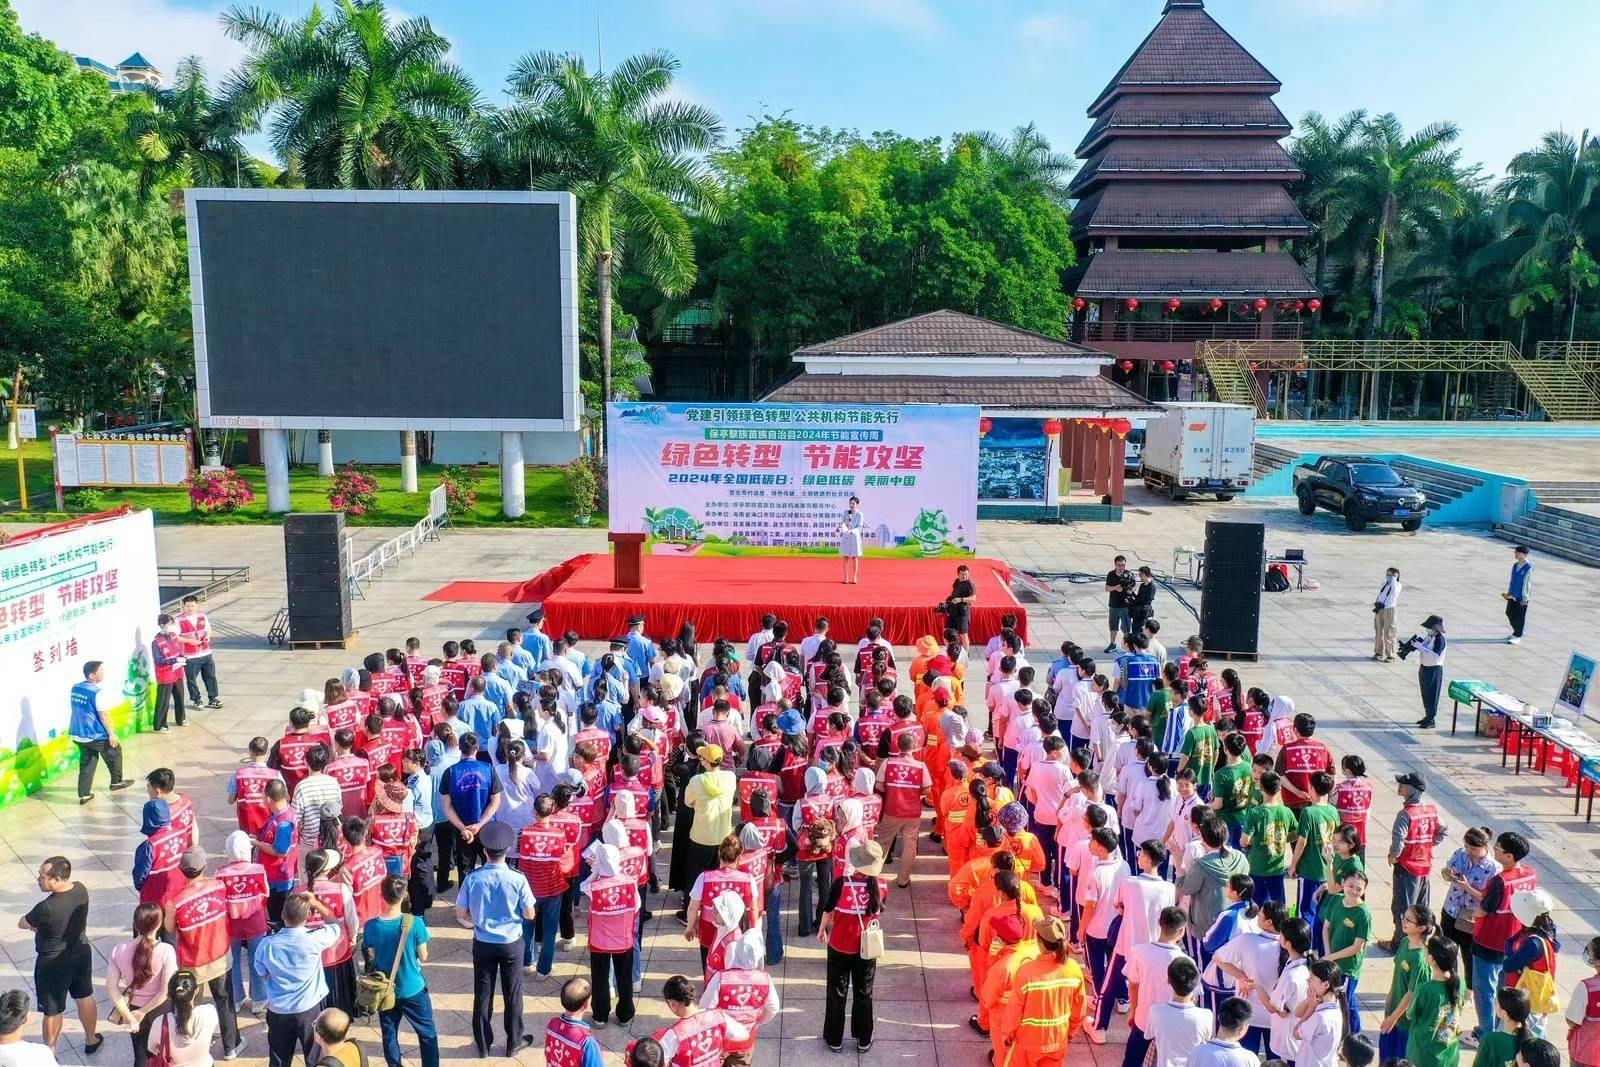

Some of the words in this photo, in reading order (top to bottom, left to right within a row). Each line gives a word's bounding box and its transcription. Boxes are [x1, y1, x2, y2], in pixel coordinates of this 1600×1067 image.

[687, 408, 790, 422] 党建引领绿色转型
[795, 410, 899, 424] 公共机构节能先行
[709, 429, 879, 441] 保亭黎族苗族自治县2024年节能宣传周
[661, 442, 781, 468] 绿色转型
[803, 444, 924, 470] 节能攻坚
[802, 475, 854, 486] 绿色低碳
[864, 475, 916, 487] 美丽中国
[58, 568, 119, 607] 节能攻坚
[33, 635, 79, 672] 签到墙
